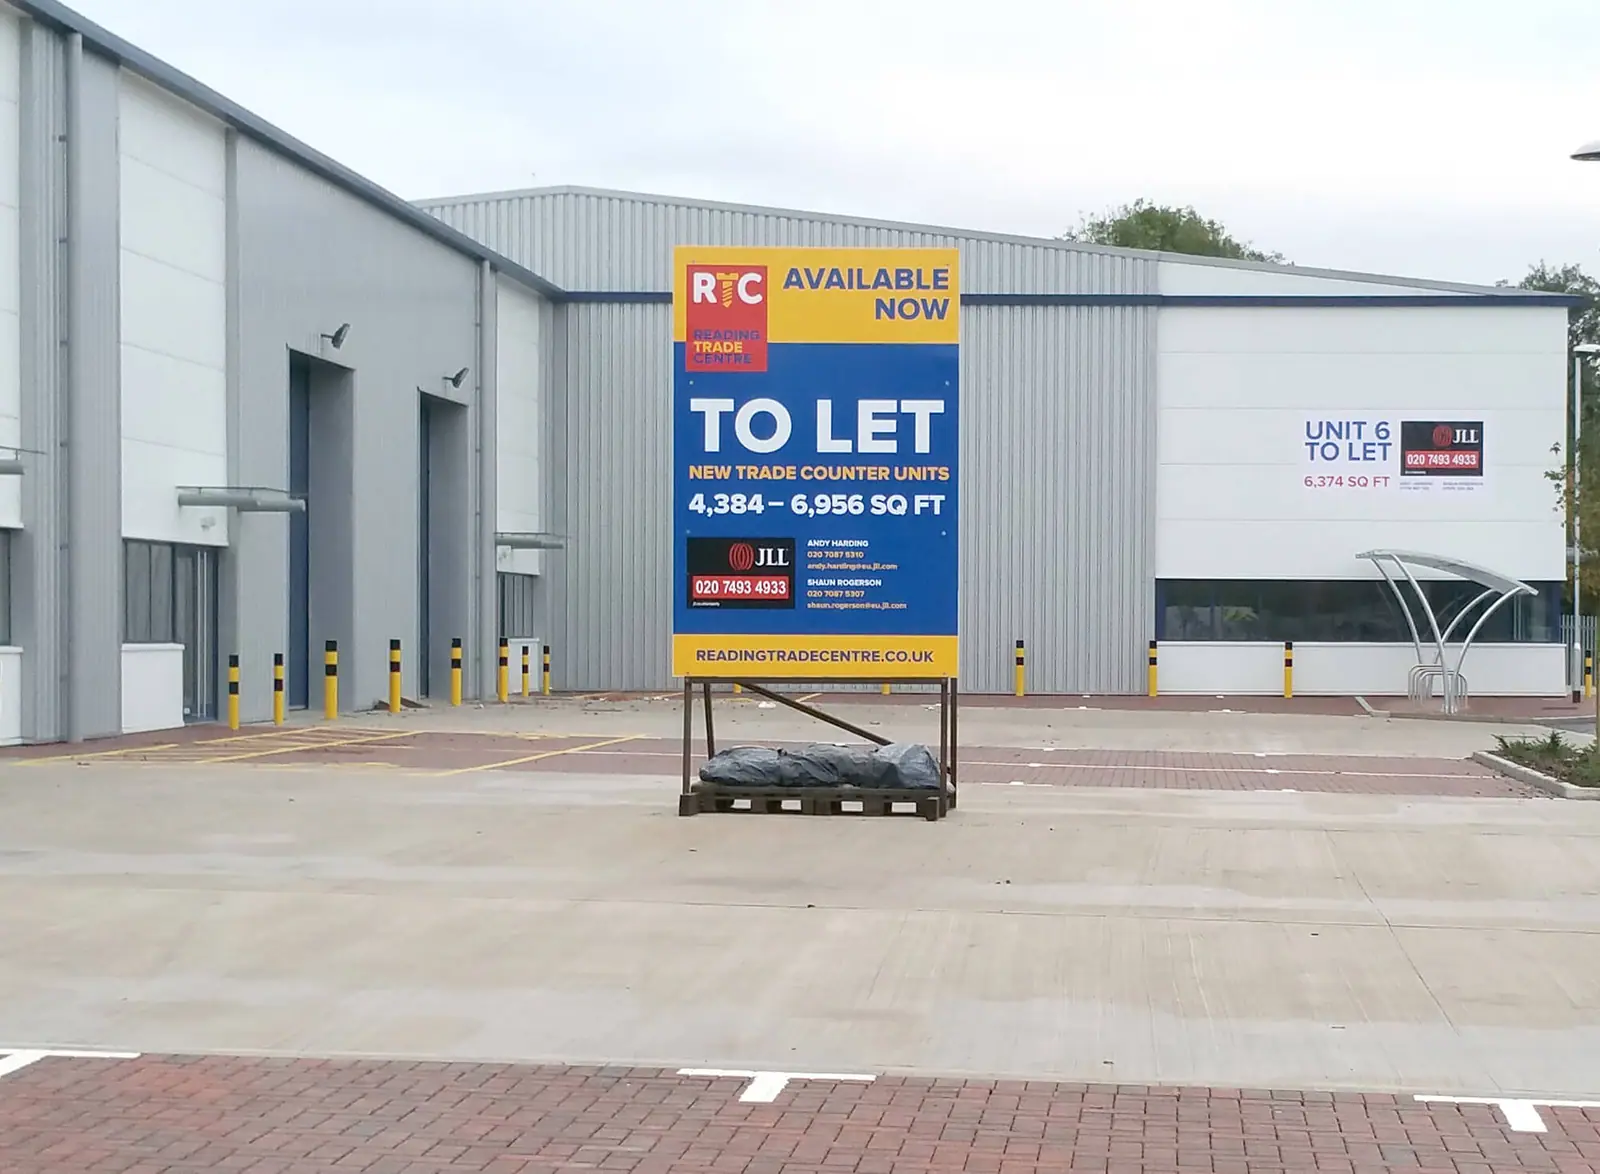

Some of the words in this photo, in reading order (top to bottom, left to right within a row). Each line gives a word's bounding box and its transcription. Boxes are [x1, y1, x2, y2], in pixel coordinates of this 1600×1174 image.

[783, 267, 949, 290] AVAILABLE
[693, 271, 763, 308] RTC
[875, 298, 950, 320] NOW
[693, 329, 760, 341] READING
[693, 341, 743, 353] TRADE
[693, 353, 752, 364] CENTRE
[690, 397, 792, 454] TO
[816, 399, 945, 454] LET
[1305, 421, 1367, 440] UNIT
[1375, 421, 1390, 440] 6
[1452, 429, 1479, 444] JLL
[1305, 442, 1340, 461] TO
[1348, 442, 1392, 461] LET
[1407, 454, 1425, 465] 020
[1427, 454, 1450, 465] 7493
[1452, 454, 1477, 465] 4933
[689, 465, 731, 480] NEW
[735, 465, 796, 480] TRADE
[800, 466, 889, 480] COUNTER
[894, 466, 950, 481] UNITS
[1304, 476, 1344, 489] 6,374
[1348, 476, 1369, 488] SQ
[1373, 476, 1390, 488] FT
[688, 493, 764, 517] 4,384
[791, 494, 865, 518] 6,956
[870, 494, 908, 517] SQ
[914, 495, 946, 515] FT
[754, 548, 790, 566] JLL
[695, 580, 719, 594] 020
[722, 580, 752, 594] 7493
[755, 580, 787, 594] 4933
[837, 579, 882, 587] ROGERSON
[696, 649, 935, 664] READINGTRADECENTRE.CO.UK
